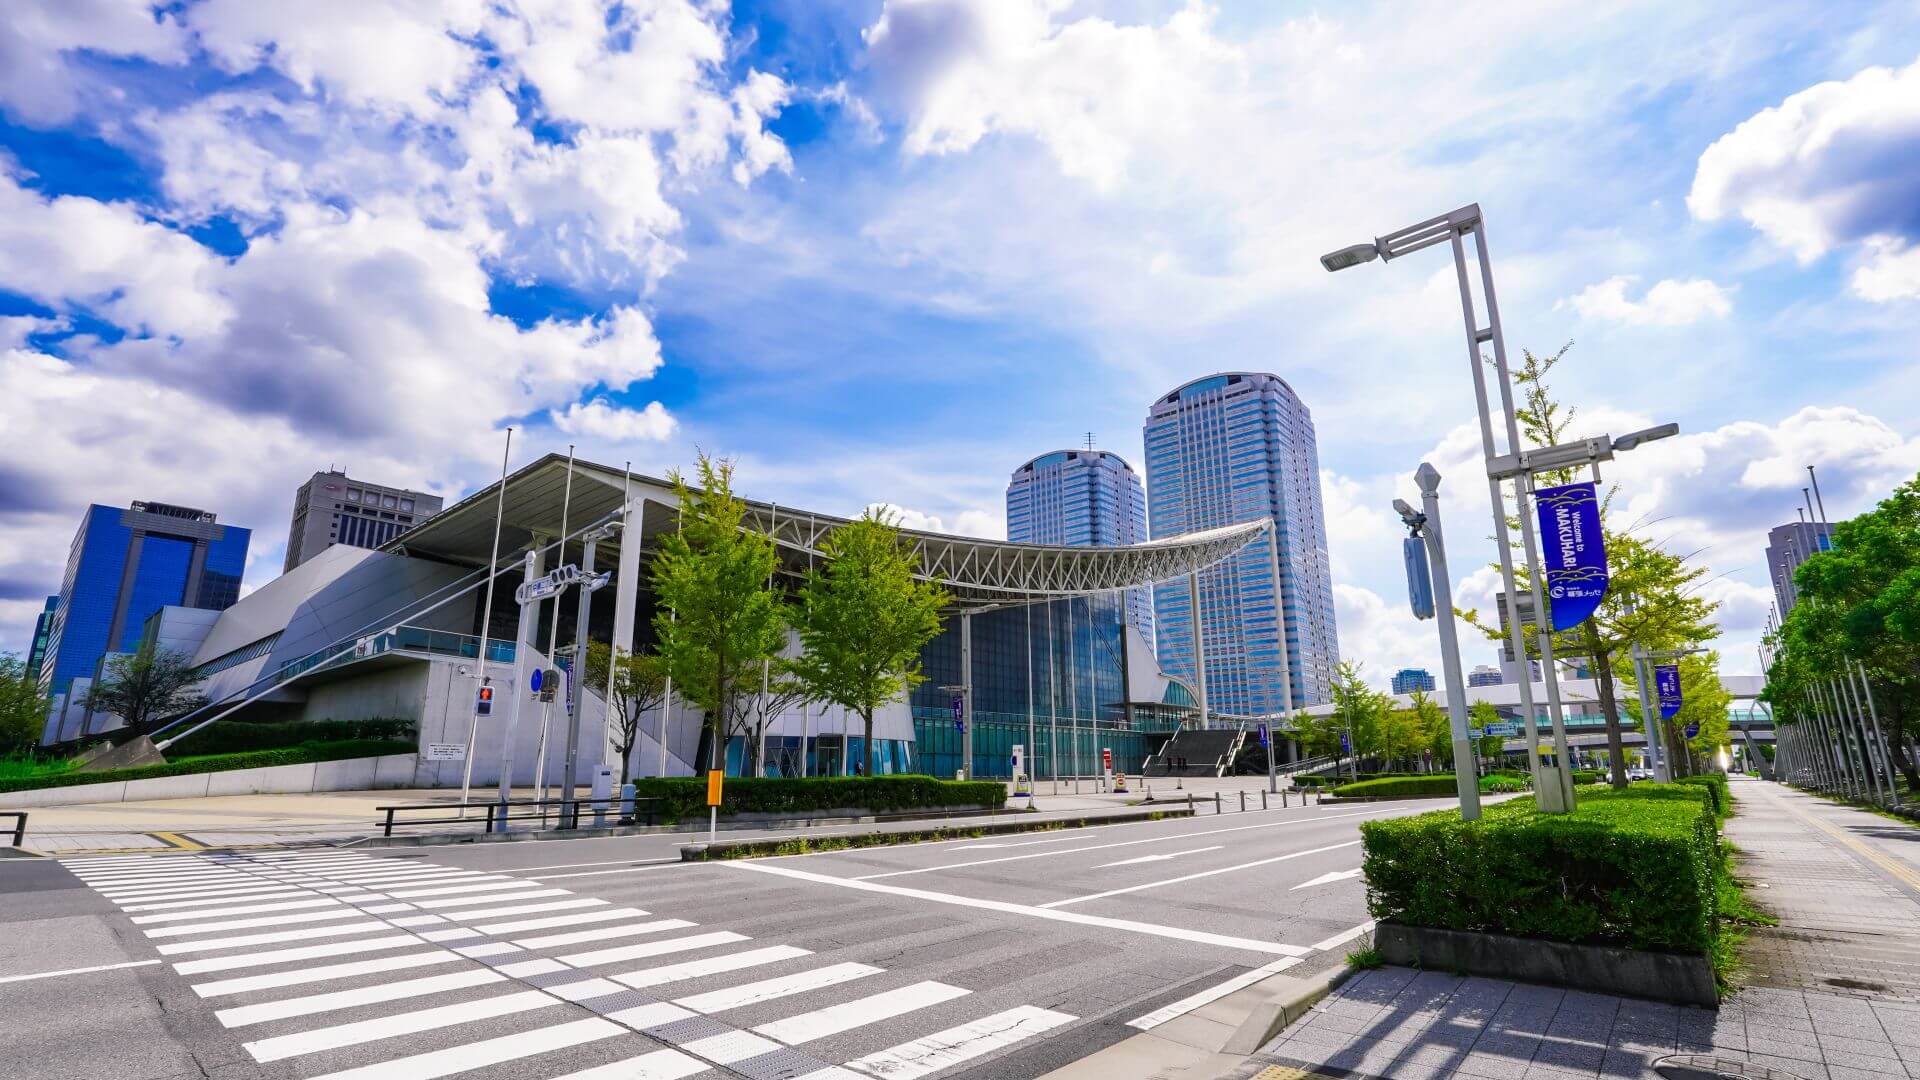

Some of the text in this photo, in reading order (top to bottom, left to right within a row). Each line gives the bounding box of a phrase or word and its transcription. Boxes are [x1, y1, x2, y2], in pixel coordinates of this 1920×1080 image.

[1555, 508, 1577, 568] MAKUHARI
[1572, 511, 1584, 552] Welcome to
